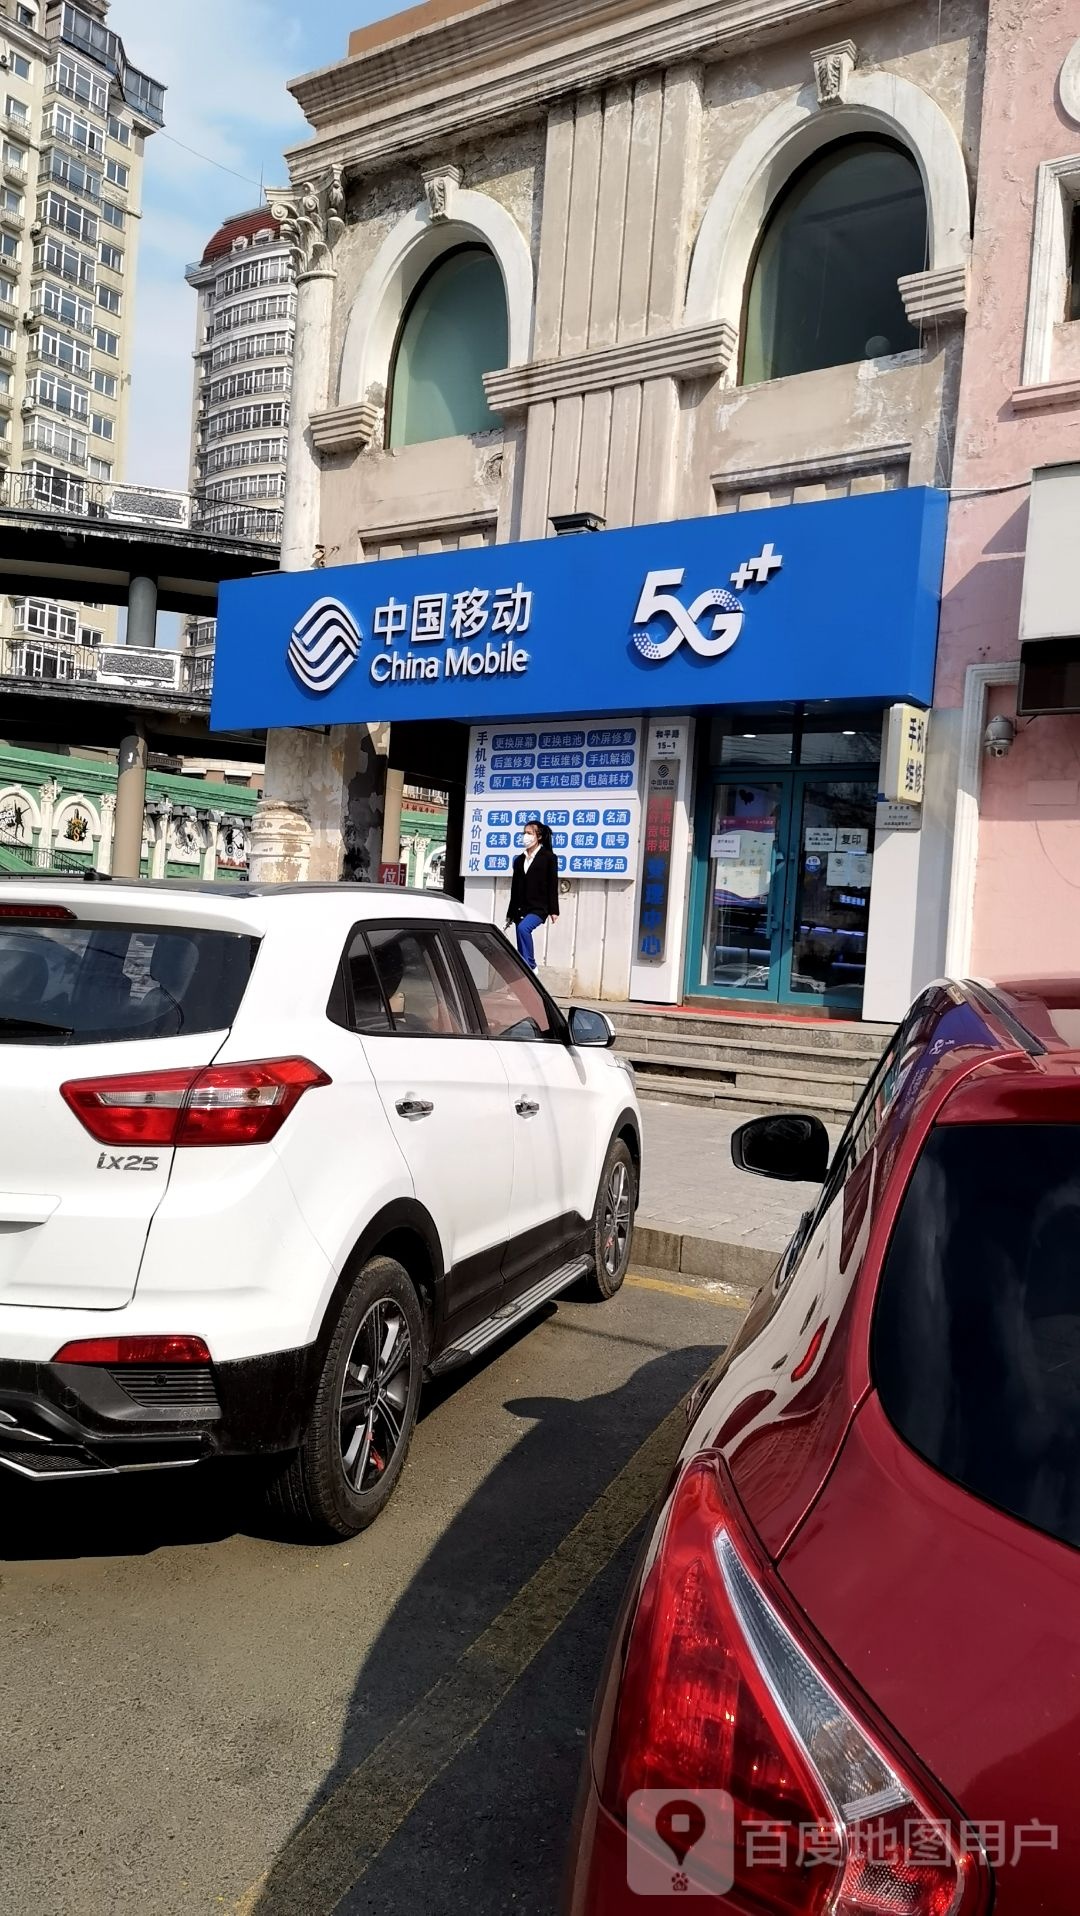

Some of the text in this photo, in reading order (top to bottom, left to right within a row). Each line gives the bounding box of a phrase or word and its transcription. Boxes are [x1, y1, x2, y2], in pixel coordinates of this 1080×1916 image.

[372, 581, 533, 646] 中国移动
[370, 640, 529, 682] China Mobile
[495, 731, 634, 749] 更换屏幕 更换电池 外屏修复
[655, 730, 680, 739] 和平路
[908, 718, 925, 753] 手机
[657, 741, 676, 750] 15-1
[472, 731, 489, 796] 手机维修
[493, 752, 632, 769] 后盖修复 主板维修 手机解锁
[491, 773, 630, 788] 原厂配件 手机包膜 电脑耗材
[905, 758, 923, 793] 维修
[490, 812, 510, 824] 手机
[546, 812, 567, 824] 钻石
[575, 812, 596, 824] 名烟
[606, 811, 628, 824] 名酒
[468, 808, 484, 873] 高价回收
[488, 833, 508, 846] 名表
[573, 834, 595, 846] 貂皮
[605, 834, 627, 846] 靓号
[840, 834, 862, 845] 复印
[487, 857, 507, 868] 置换
[572, 857, 625, 870] 各种奢侈品
[96, 1152, 160, 1171] ix25
